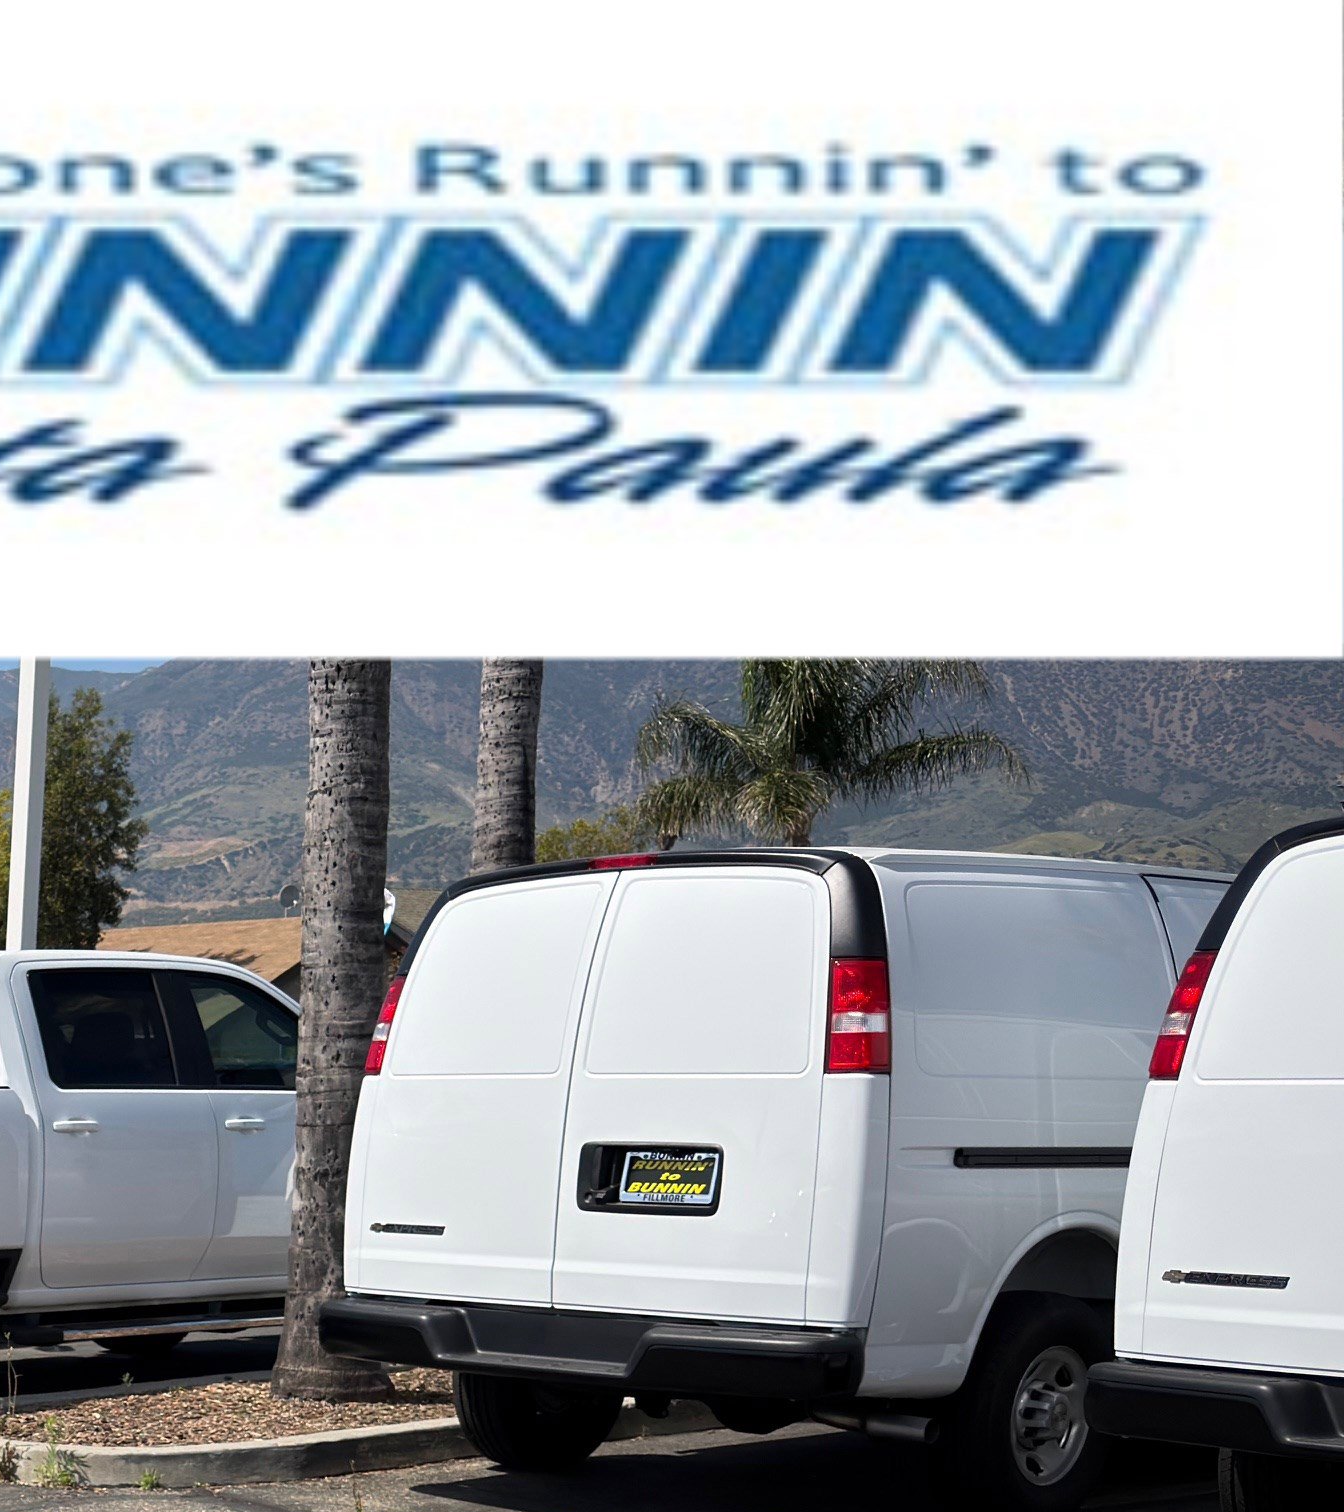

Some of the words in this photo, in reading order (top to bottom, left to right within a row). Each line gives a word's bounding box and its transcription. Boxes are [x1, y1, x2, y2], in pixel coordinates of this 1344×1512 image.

[631, 1160, 714, 1172] RUNNIN'
[659, 1172, 682, 1181] to
[627, 1182, 707, 1195] BUNNIN
[643, 1193, 686, 1203] FILLMORE
